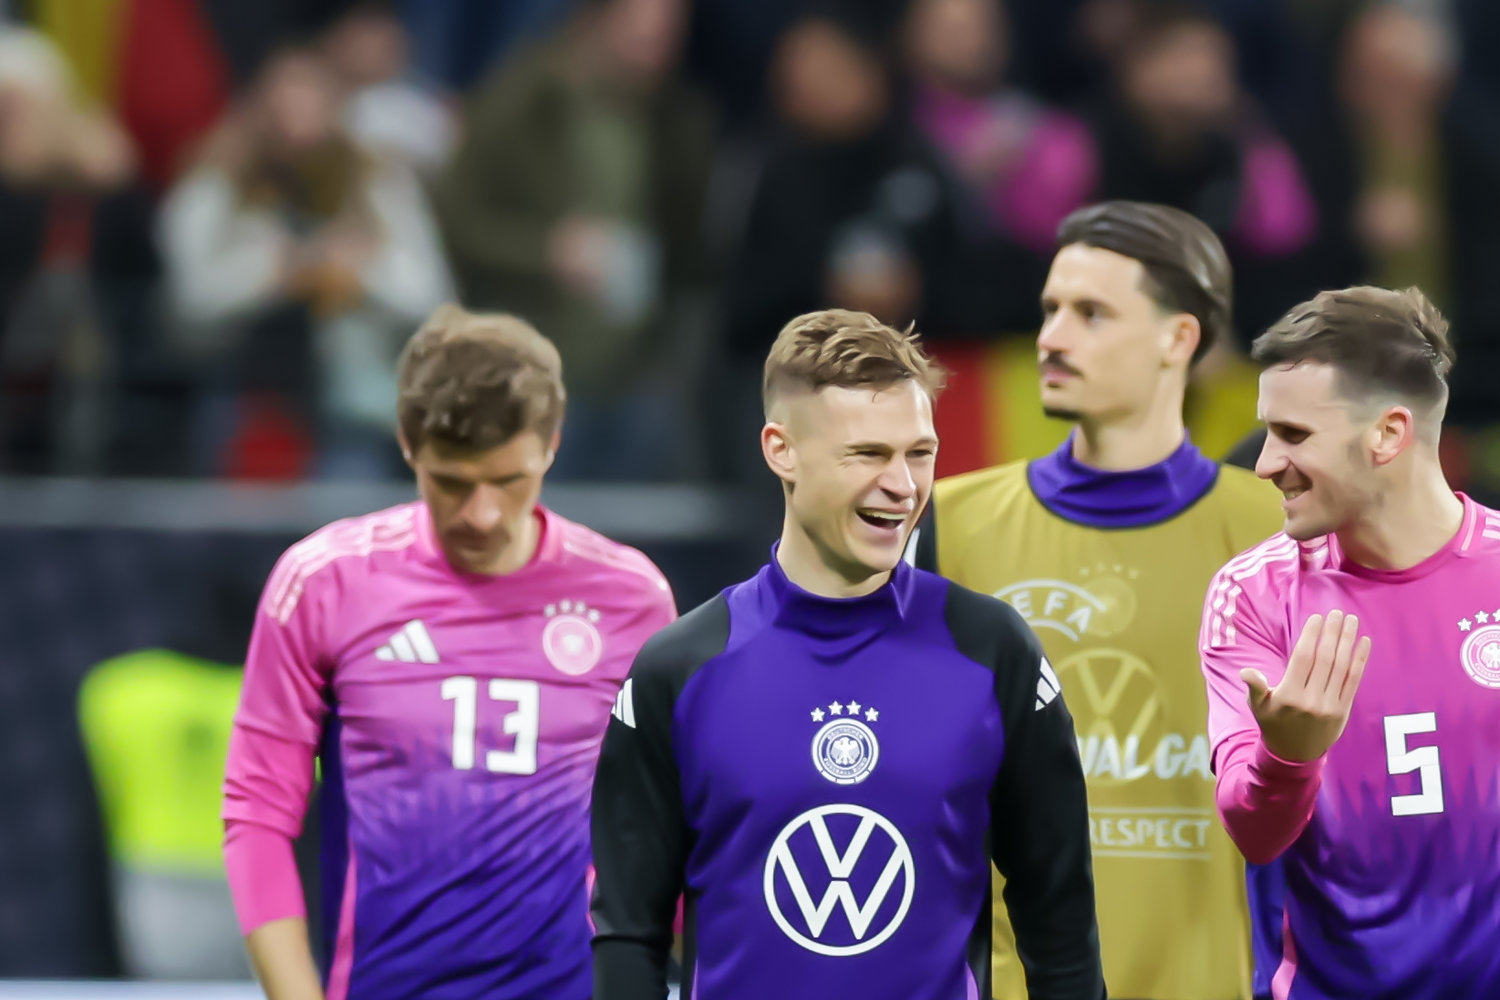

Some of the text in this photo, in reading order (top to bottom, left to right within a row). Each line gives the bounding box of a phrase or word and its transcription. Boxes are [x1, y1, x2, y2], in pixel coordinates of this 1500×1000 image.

[1012, 590, 1092, 633] EFA
[440, 675, 540, 774] 13
[1383, 711, 1445, 817] 5
[766, 806, 913, 950] VW
